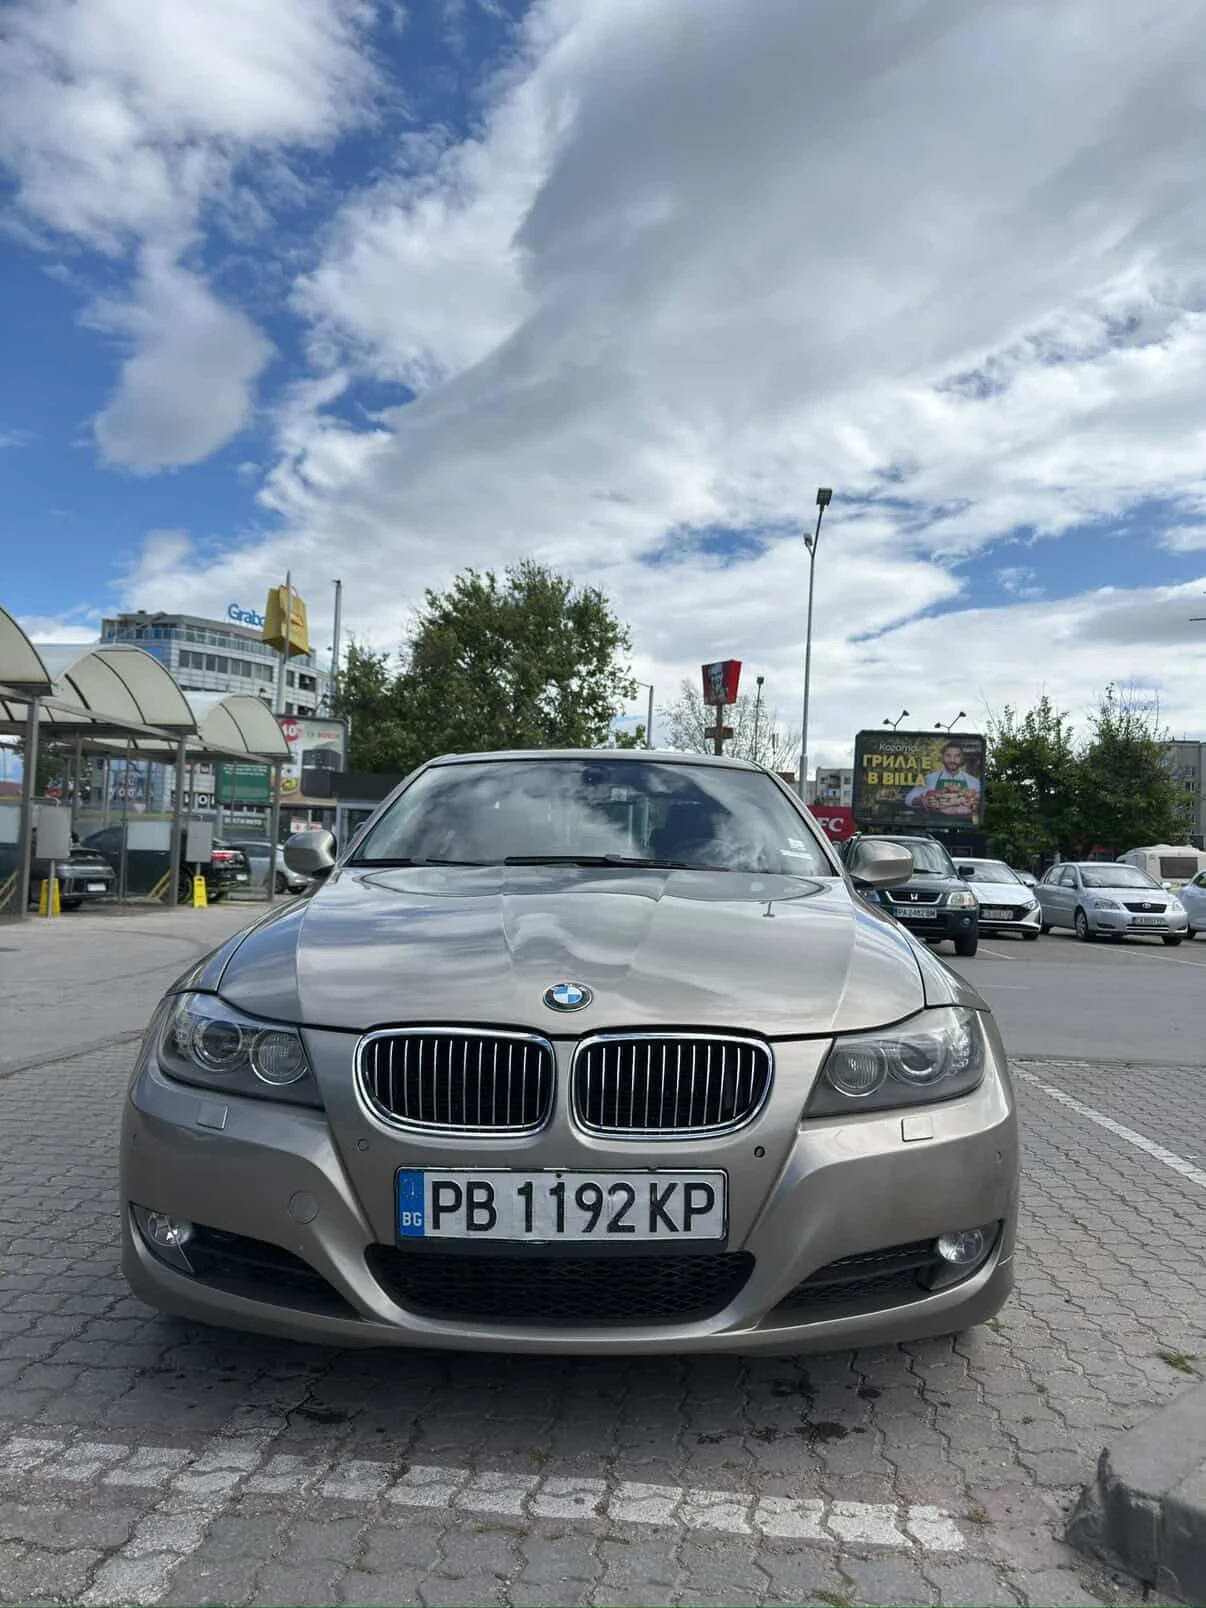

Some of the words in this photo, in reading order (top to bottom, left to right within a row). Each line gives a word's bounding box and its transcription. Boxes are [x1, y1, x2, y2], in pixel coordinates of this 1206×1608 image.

[863, 754, 917, 769] ГРИЛА
[922, 756, 932, 769] Е
[868, 772, 878, 784] В
[882, 772, 926, 786] BILLA
[816, 816, 844, 832] FC
[431, 1181, 497, 1231] PB
[517, 1181, 636, 1233] 1192
[649, 1182, 716, 1233] KP
[402, 1212, 422, 1226] BG
